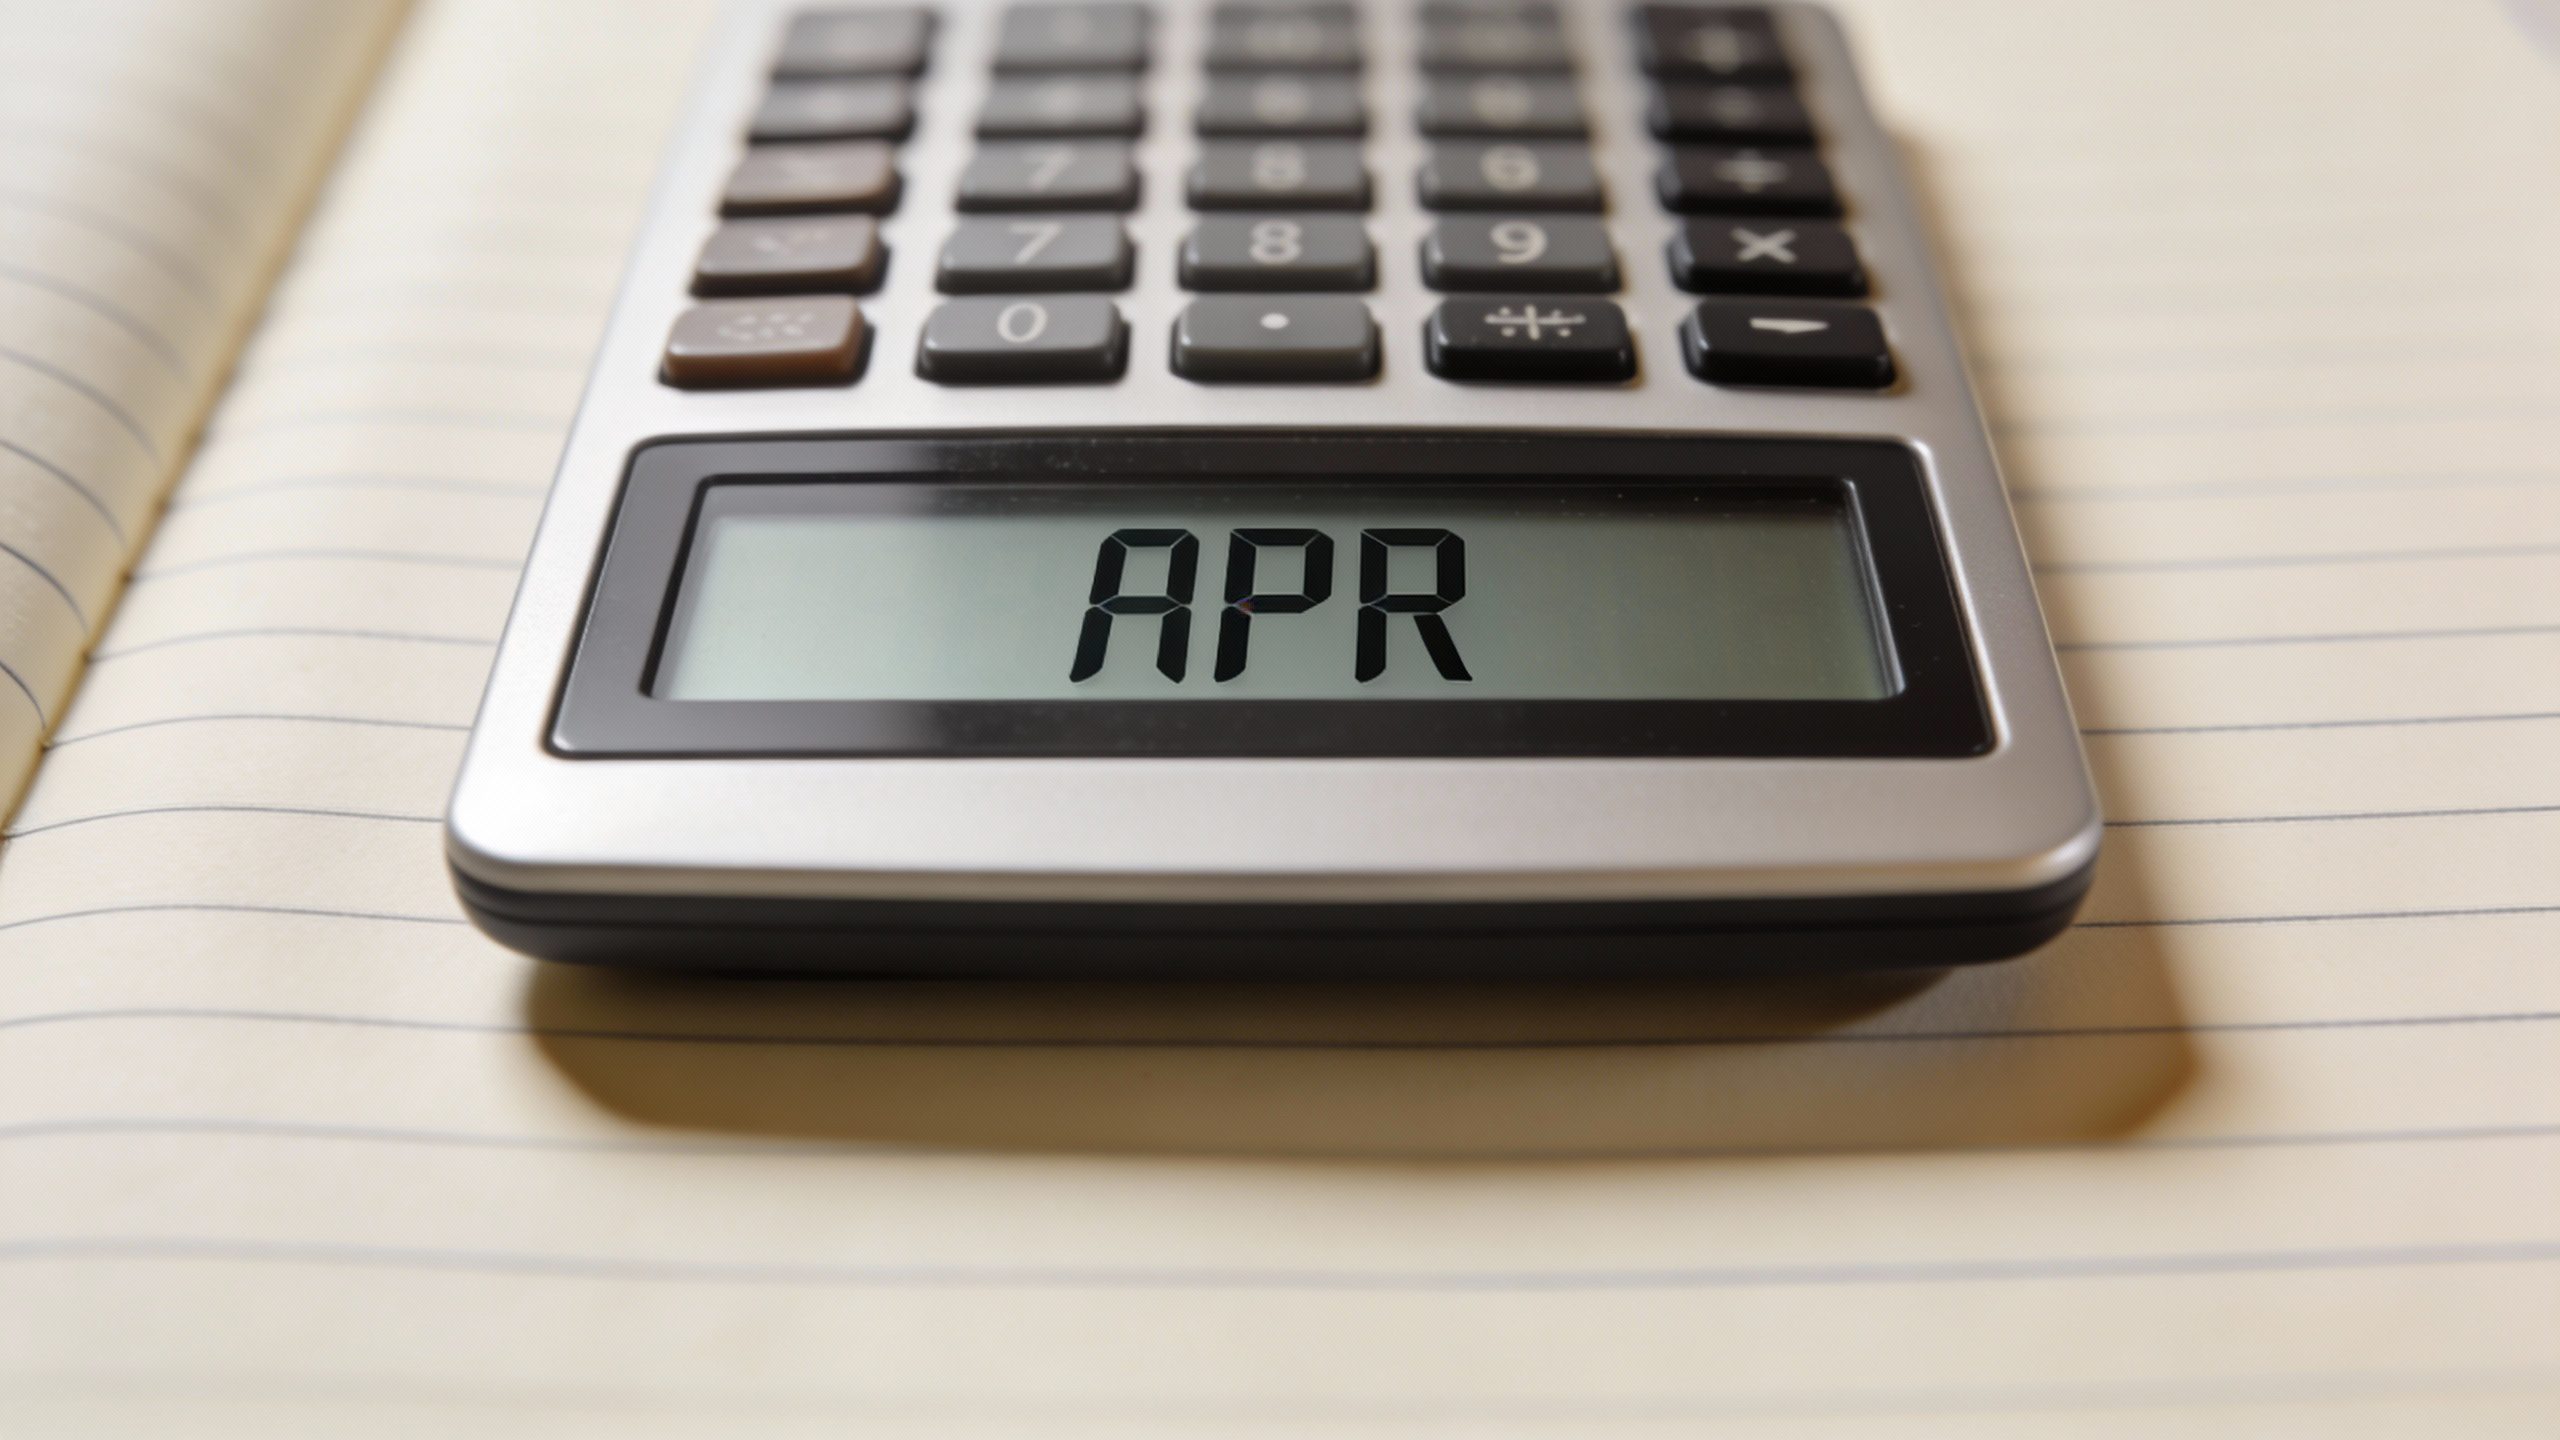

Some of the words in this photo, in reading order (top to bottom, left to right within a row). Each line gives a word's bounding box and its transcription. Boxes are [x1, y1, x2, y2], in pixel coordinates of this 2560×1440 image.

[1007, 220, 1063, 265] 7
[1250, 218, 1301, 265] 8
[1490, 219, 1547, 265] 9
[1069, 528, 1473, 684] APR
